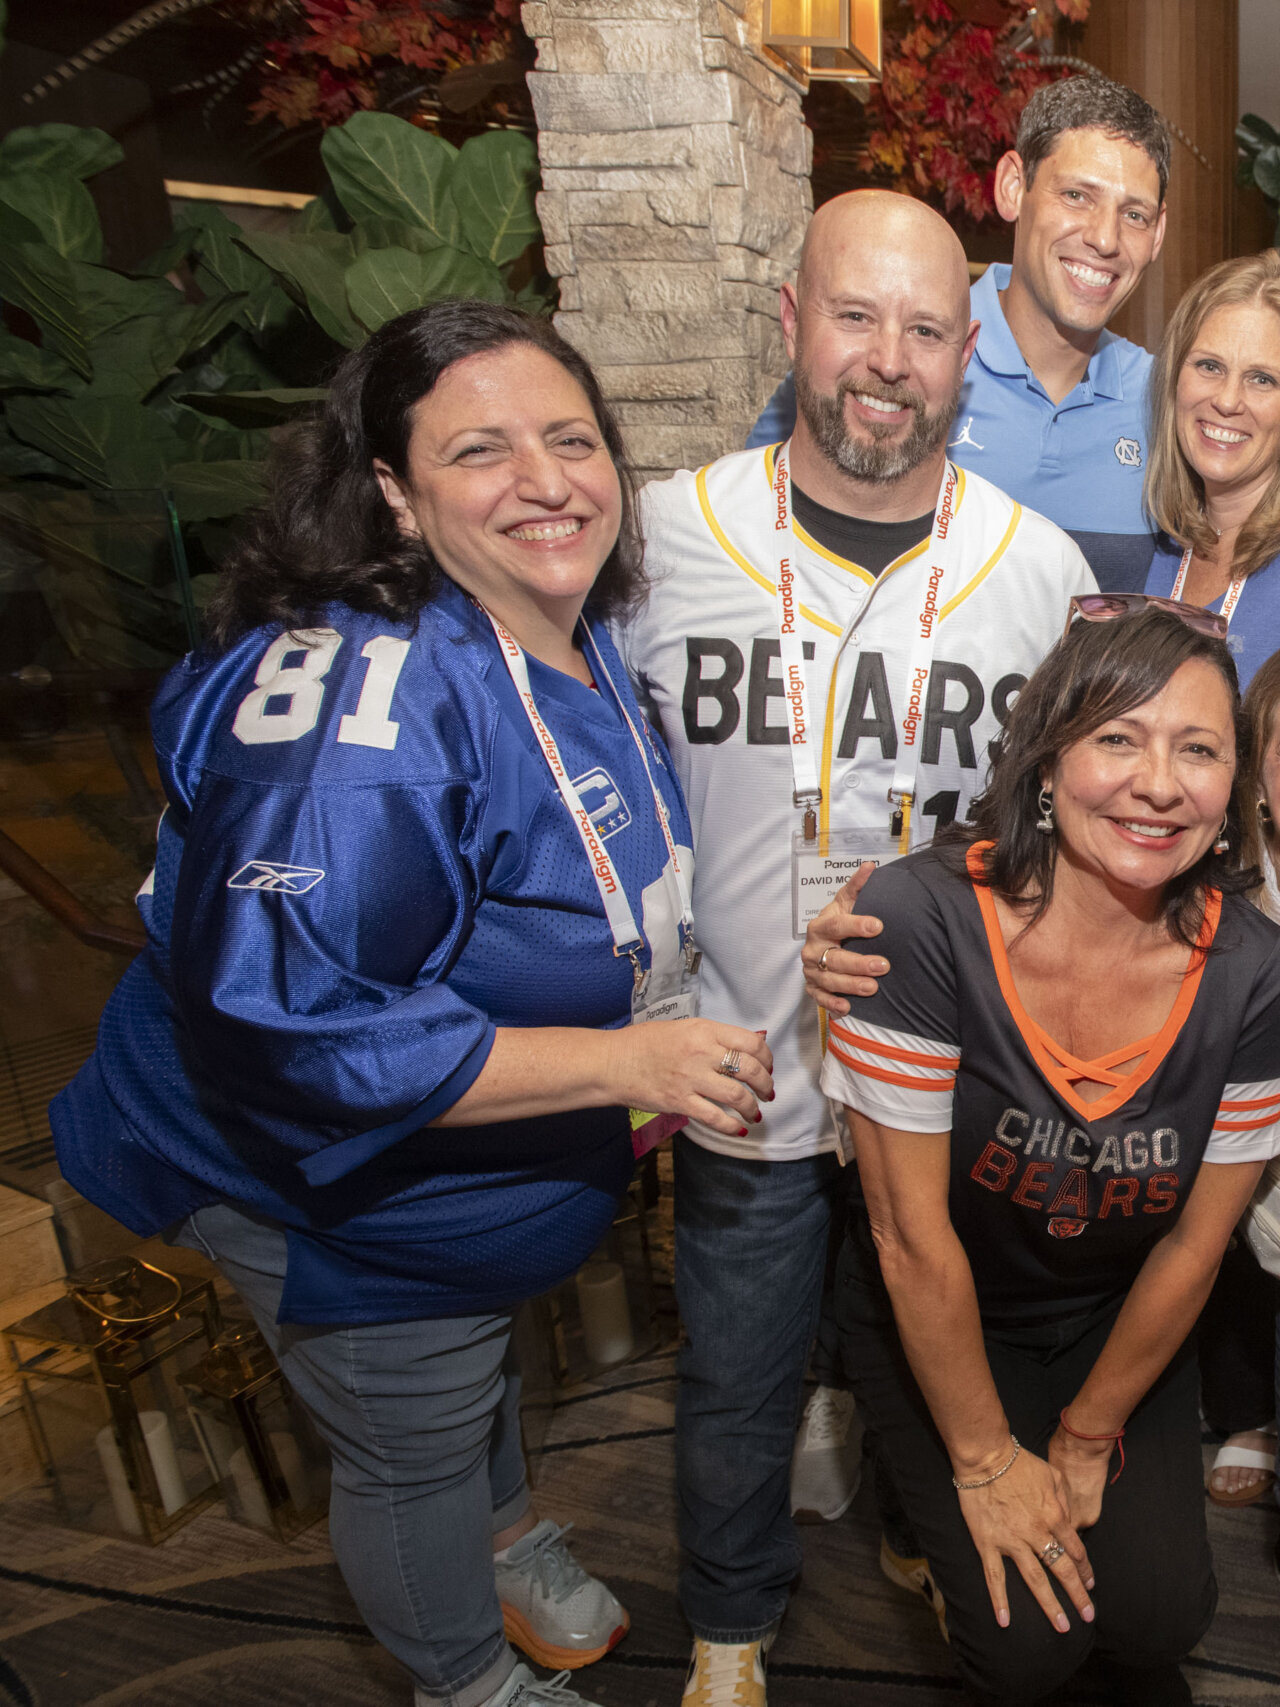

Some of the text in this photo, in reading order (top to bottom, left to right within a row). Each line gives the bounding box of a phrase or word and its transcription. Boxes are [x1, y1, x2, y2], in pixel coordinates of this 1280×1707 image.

[775, 459, 788, 531] Paradigm
[936, 472, 957, 541] Paradigm
[778, 558, 796, 635] Paradigm
[919, 566, 944, 639] Paradigm
[1223, 577, 1242, 619] adigm
[231, 627, 411, 750] 81
[788, 664, 806, 746] Paradigm
[903, 667, 928, 746] Paradigm
[523, 692, 564, 777] Paradigm
[575, 809, 617, 894] Paradigm
[801, 876, 833, 886] DAVID
[824, 859, 880, 869] Paradim
[646, 1001, 678, 1021] Paradigm
[995, 1107, 1180, 1174] CHICAGO
[970, 1140, 1180, 1220] BEARS
